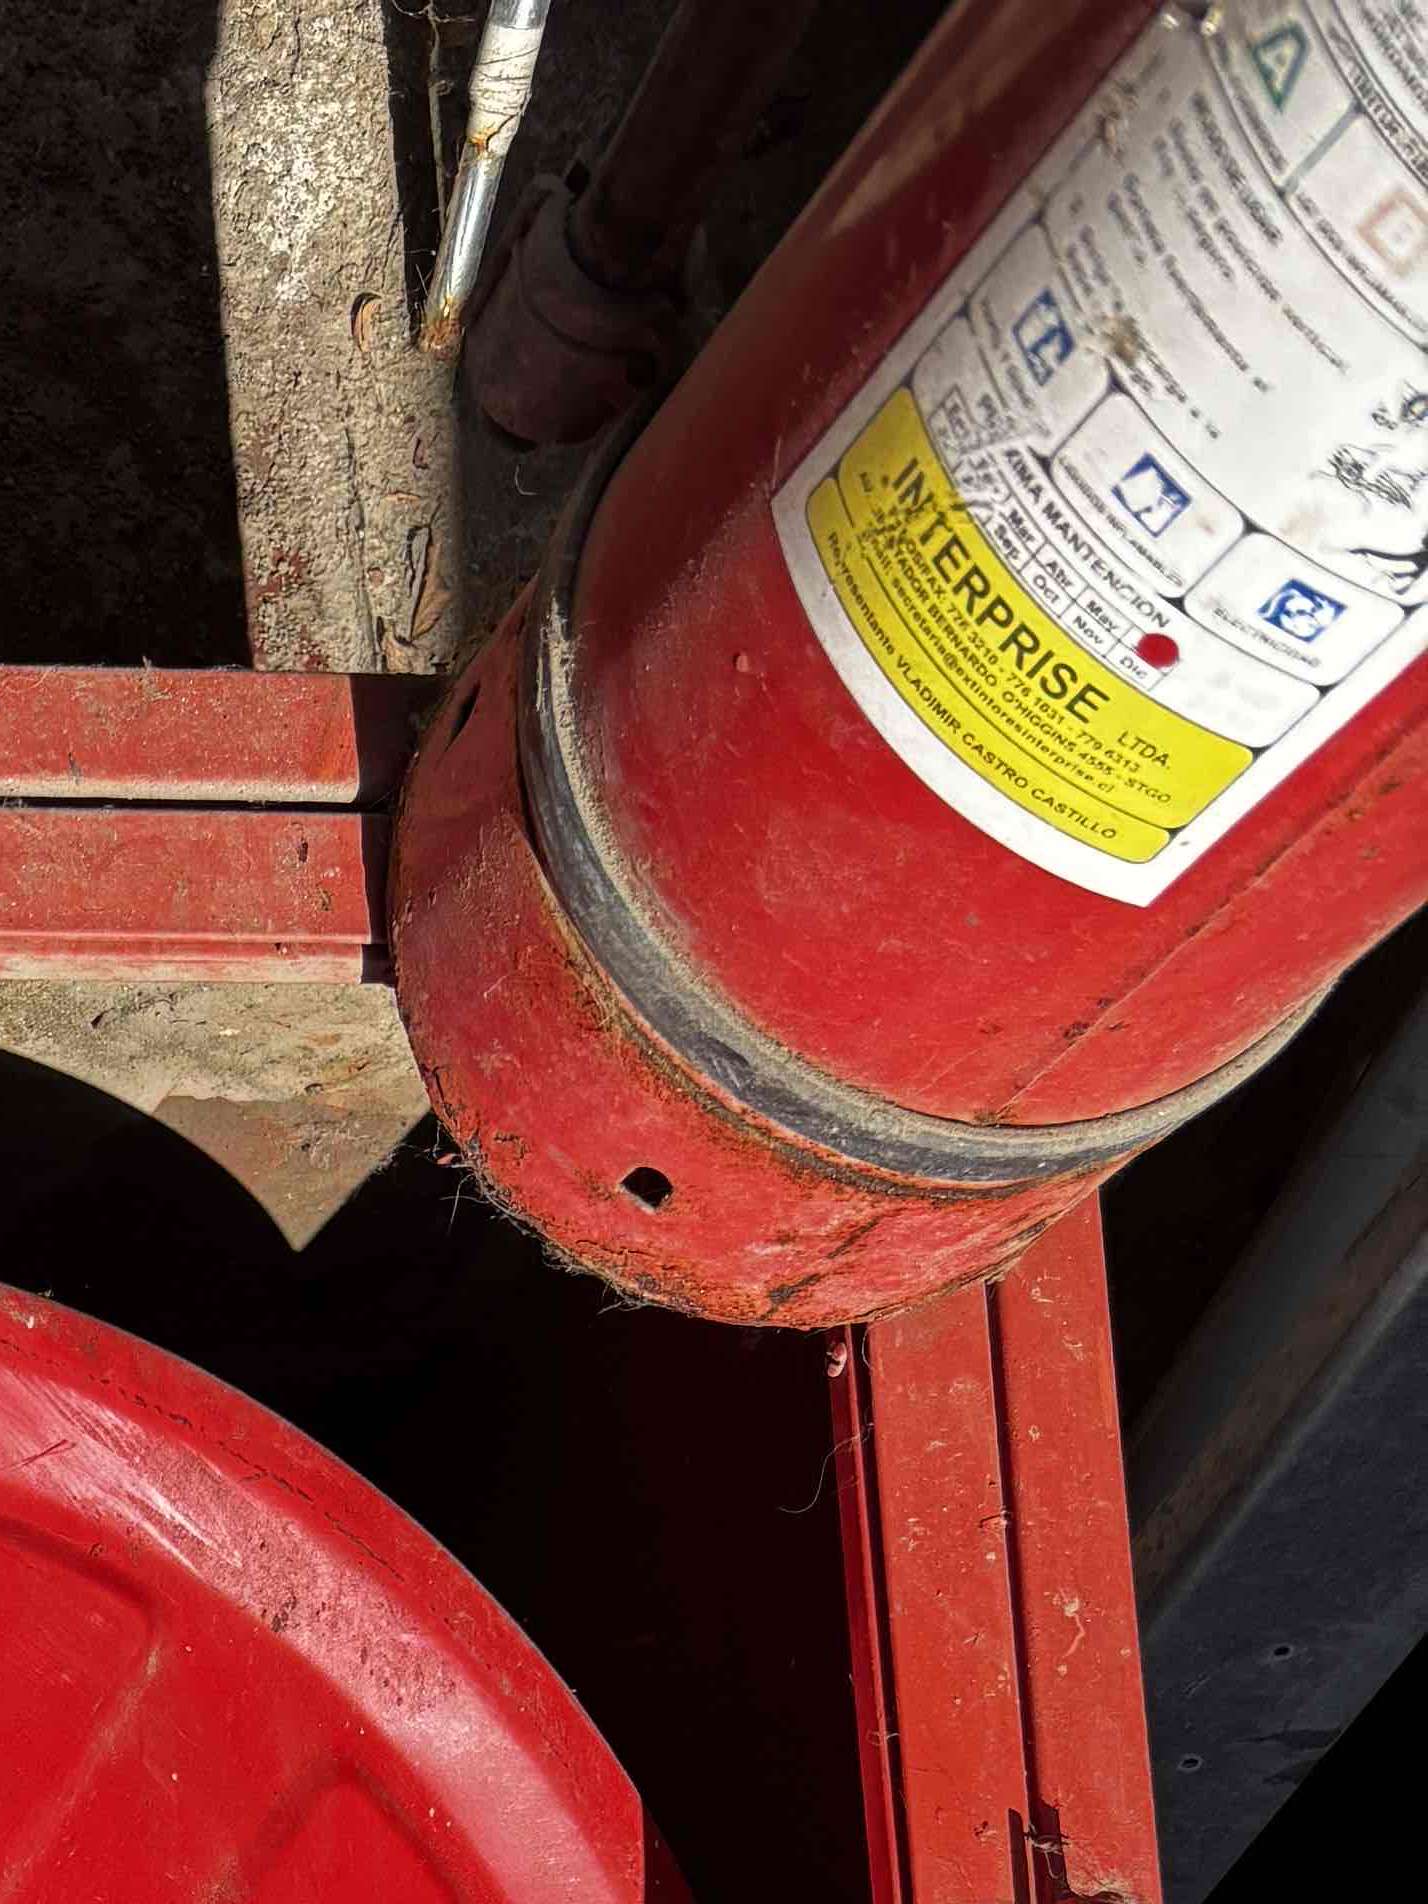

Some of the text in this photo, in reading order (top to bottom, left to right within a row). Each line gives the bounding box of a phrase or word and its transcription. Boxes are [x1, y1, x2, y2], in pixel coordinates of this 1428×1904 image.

[994, 524, 1020, 560] Sep
[1032, 573, 1060, 604] Oct
[1072, 614, 1104, 644] Nov
[1008, 509, 1035, 542] Mar
[1086, 599, 1118, 631] May
[926, 603, 998, 688] BERNARDO
[897, 654, 962, 734] VLADIMIR
[961, 732, 1030, 789] CASTRO
[1030, 787, 1118, 840] CASTILLO
[1115, 730, 1168, 770] LTDA.
